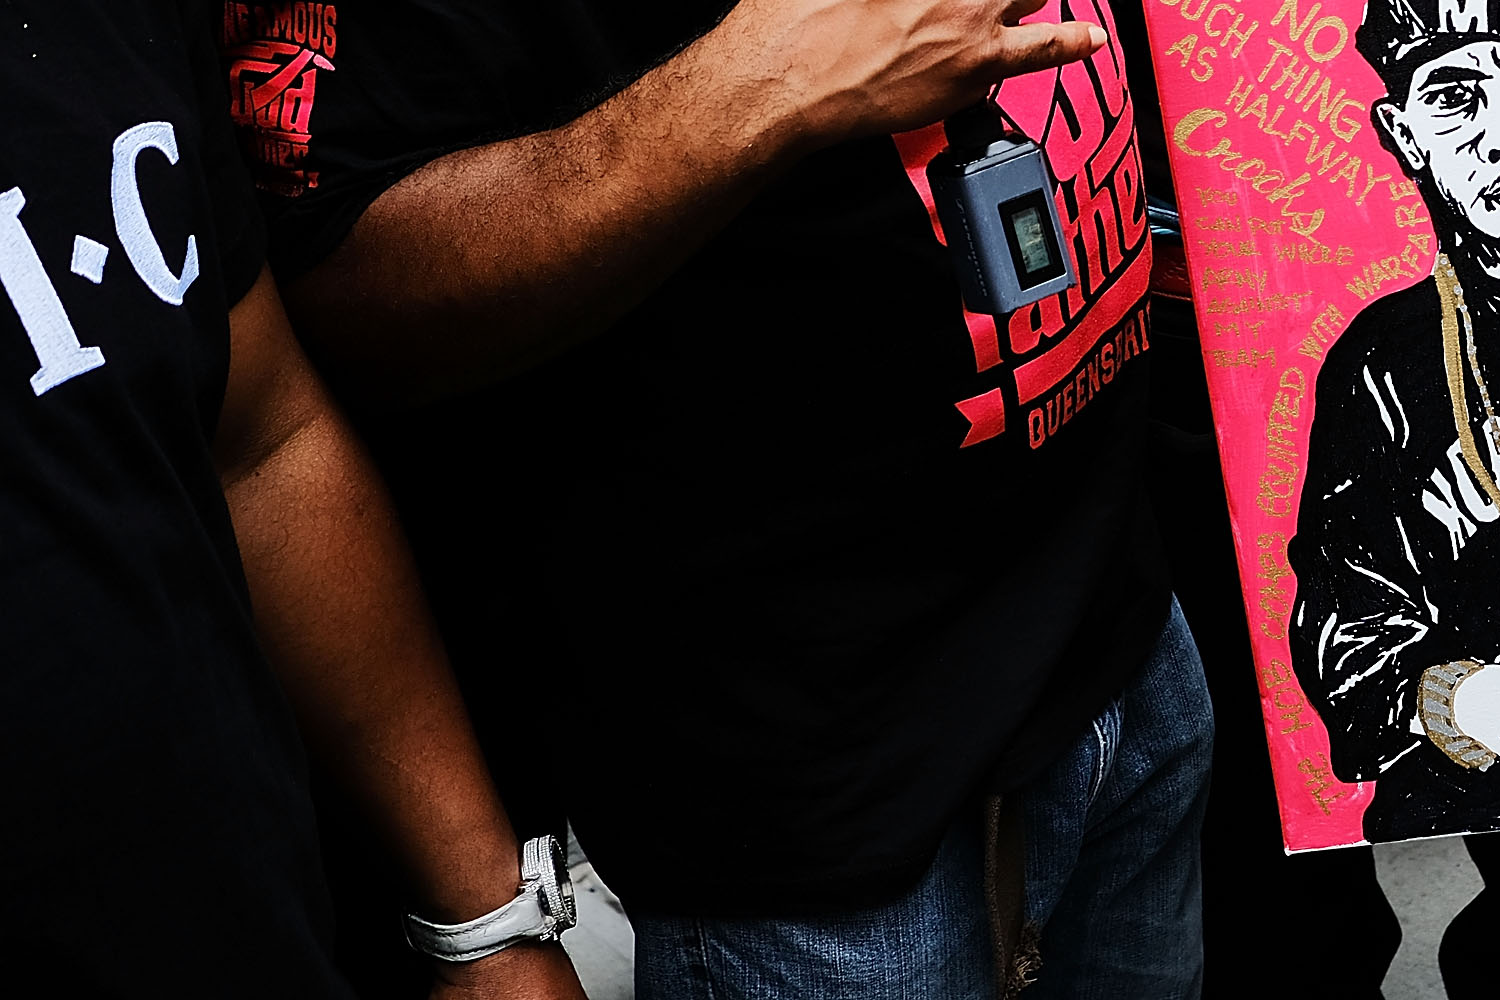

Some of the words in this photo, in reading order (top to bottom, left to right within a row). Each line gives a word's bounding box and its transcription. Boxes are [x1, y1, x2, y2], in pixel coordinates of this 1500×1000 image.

[1164, 33, 1218, 83] AS
[1224, 75, 1392, 207] HALFWAY
[1257, 36, 1367, 143] THING
[1345, 179, 1433, 301] WARFARE
[1028, 300, 1150, 450] QUEENSBRI
[1298, 303, 1347, 362] WITH
[1296, 750, 1348, 817] THE
